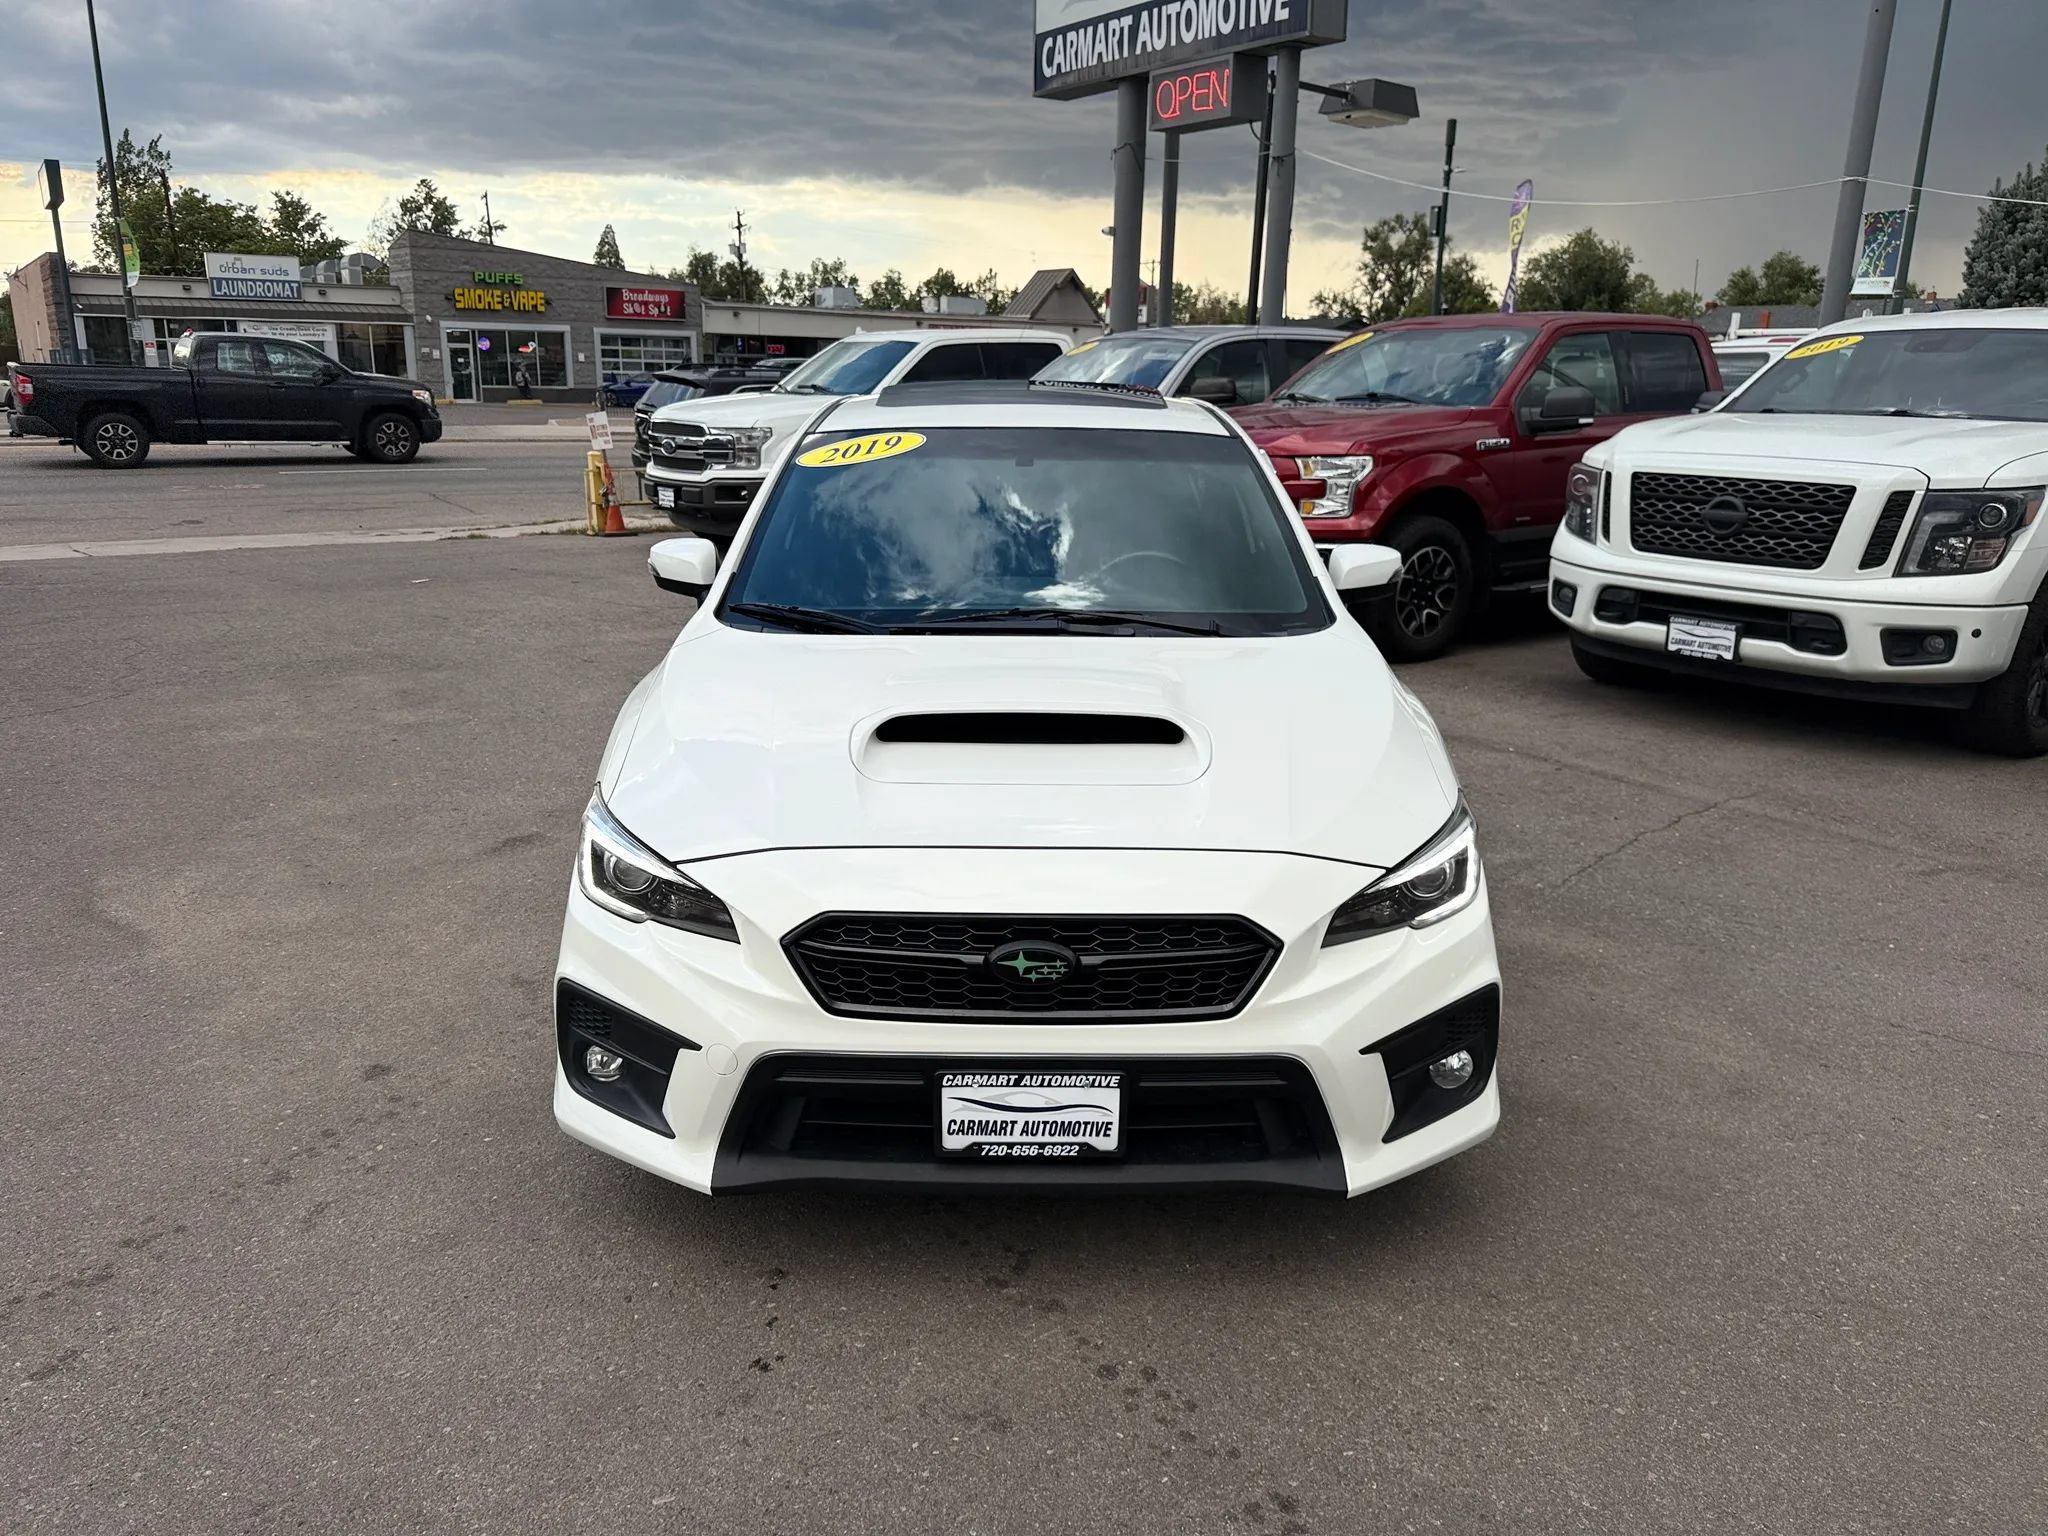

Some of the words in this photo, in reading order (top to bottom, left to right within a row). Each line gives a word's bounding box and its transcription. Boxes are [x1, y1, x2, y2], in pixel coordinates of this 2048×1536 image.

[1041, 15, 1133, 78] CARMART
[1135, 0, 1289, 55] AUTOMOTIVE
[1156, 69, 1230, 119] OPEN
[219, 261, 256, 275] urban
[260, 267, 289, 276] suds
[473, 271, 524, 285] PUFFS
[213, 279, 299, 298] LAUNDROMAT
[454, 287, 503, 310] SMOKE
[511, 290, 545, 313] VAPE
[819, 435, 902, 463] 2019
[942, 1075, 1018, 1087] CARMART
[1020, 1075, 1120, 1087] AUTOMOTIVE
[947, 1119, 1018, 1137] CARMART
[1020, 1120, 1113, 1138] AUTOMOTIVE
[981, 1145, 1079, 1156] 720-656-6922
